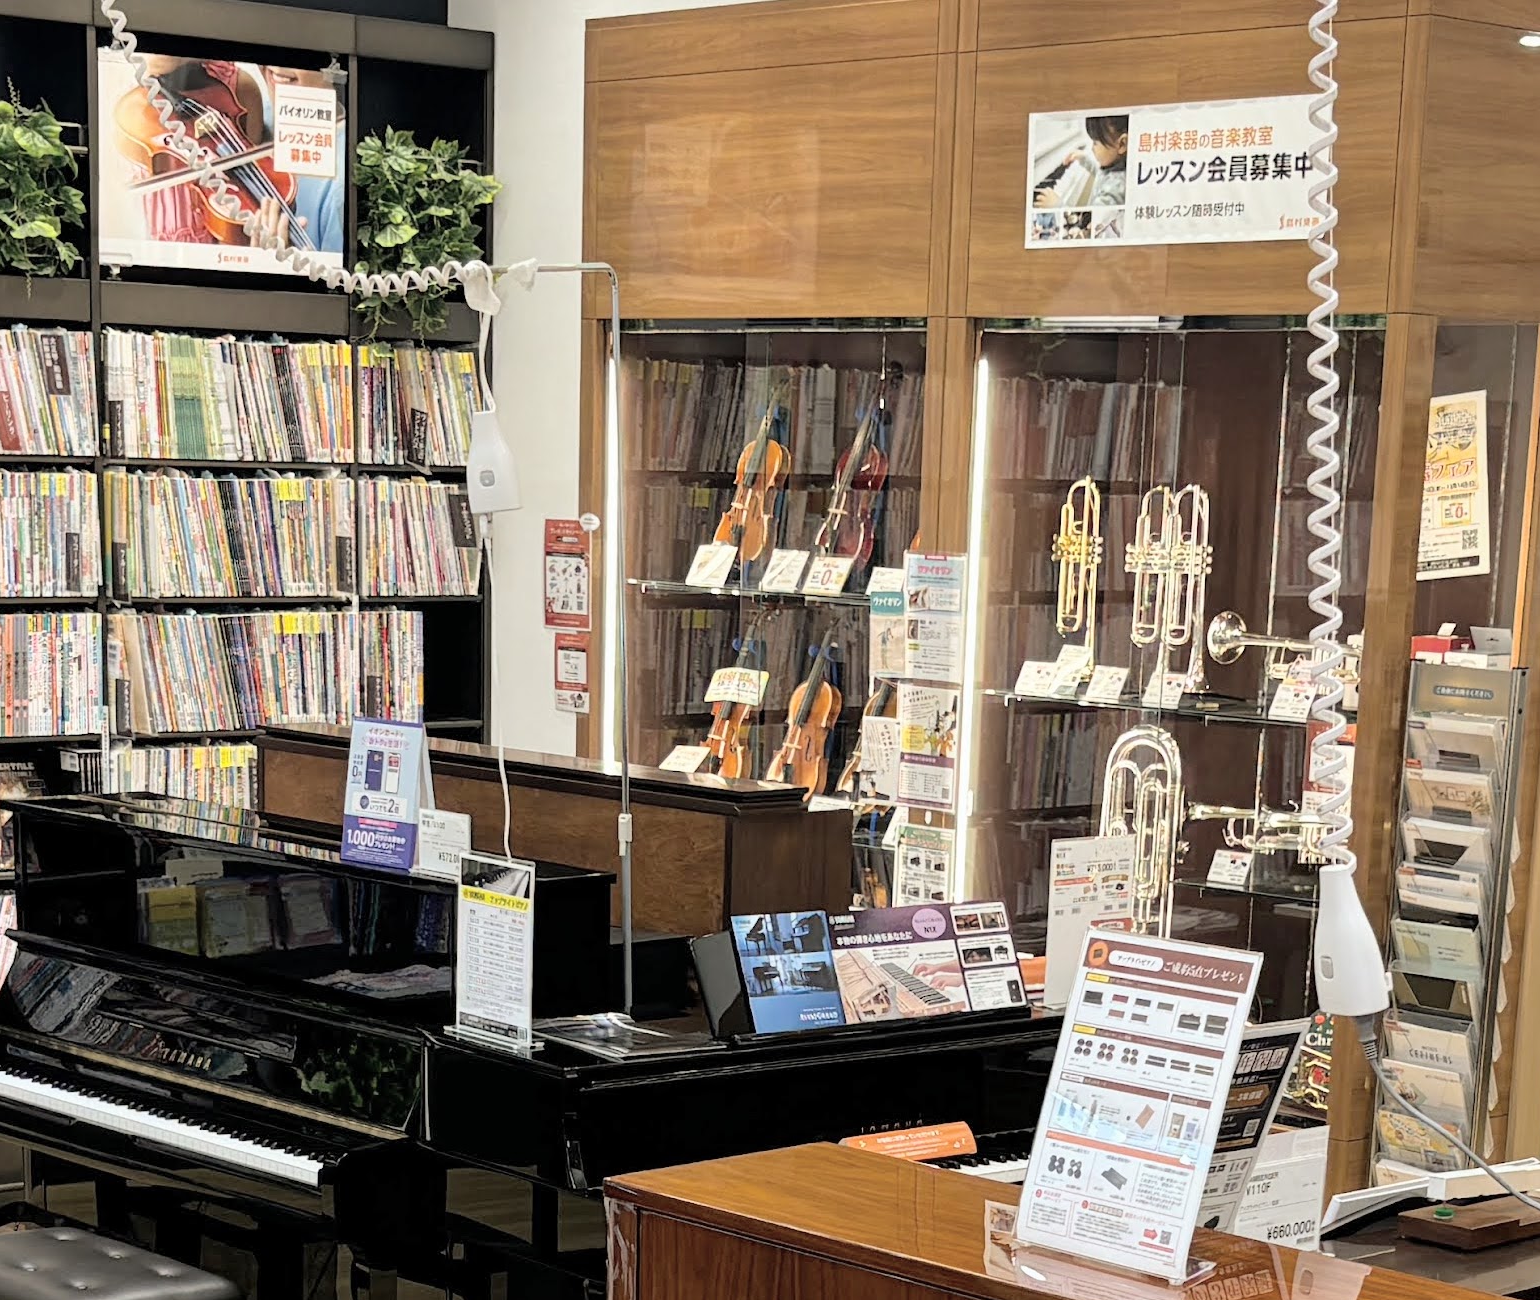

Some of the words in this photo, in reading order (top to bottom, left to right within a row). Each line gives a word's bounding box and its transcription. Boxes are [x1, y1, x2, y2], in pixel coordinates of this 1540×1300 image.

[279, 104, 333, 123] バイオリン教室
[279, 130, 333, 149] レッスン会員
[1138, 126, 1274, 153] 島村楽器の音楽教室
[290, 149, 322, 164] 募集中
[1137, 151, 1313, 185] レッスン会員募集中
[1267, 1220, 1311, 1241] ¥660,000
